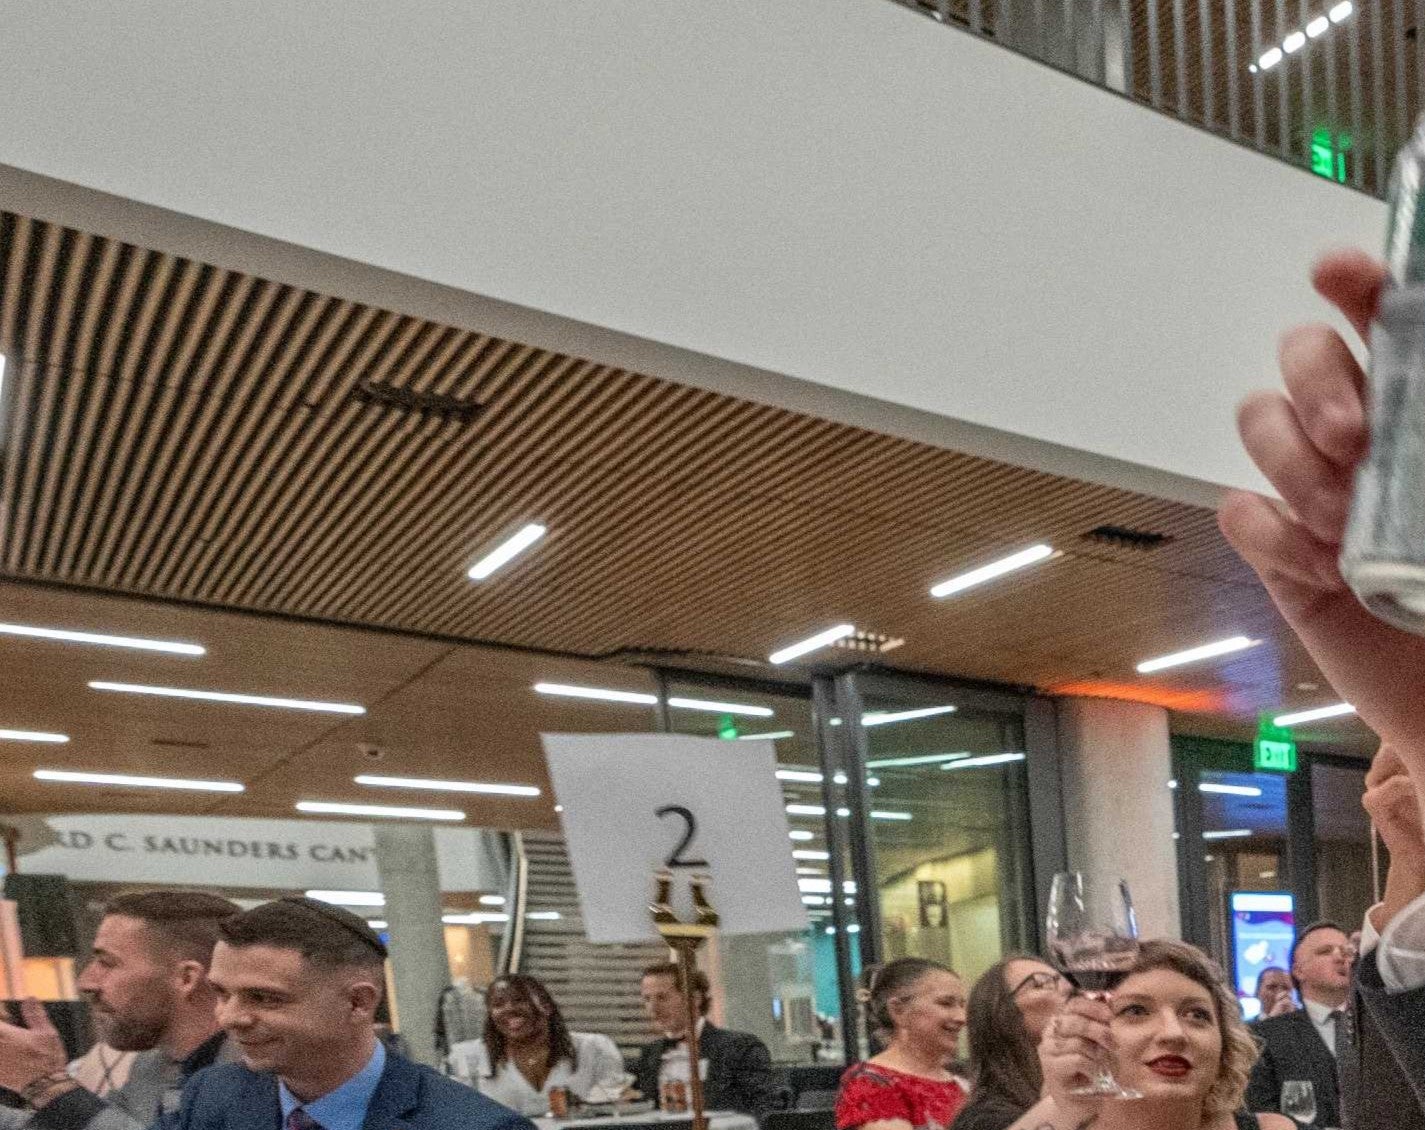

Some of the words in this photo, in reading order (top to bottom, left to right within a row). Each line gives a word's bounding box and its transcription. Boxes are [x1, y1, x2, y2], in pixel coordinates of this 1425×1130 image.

[144, 834, 299, 861] SAUNDERS
[308, 843, 378, 863] CAN
[654, 804, 711, 869] 2
